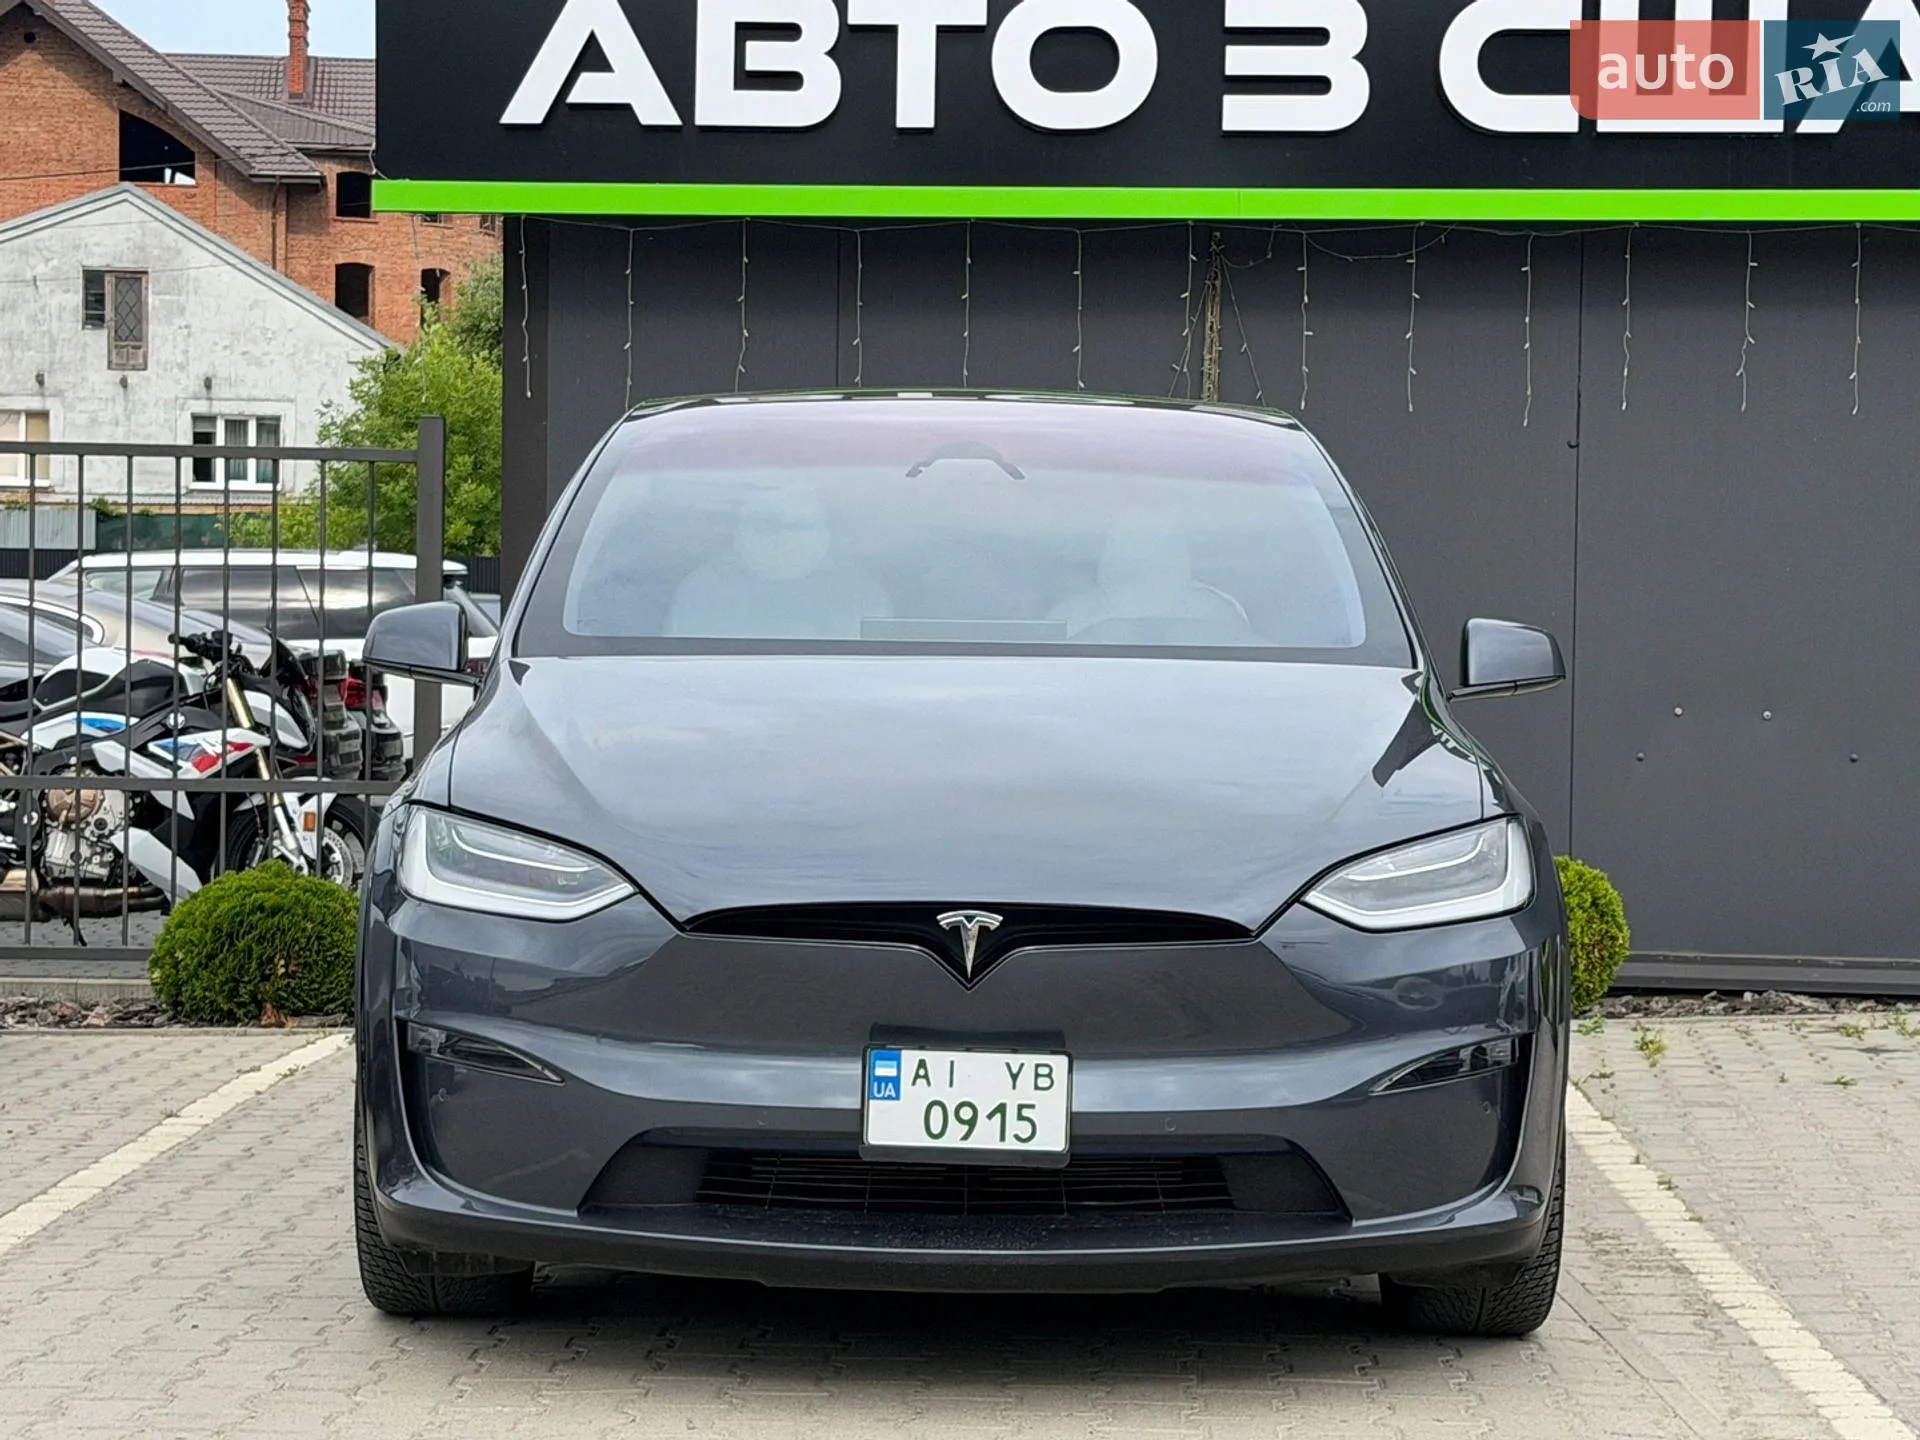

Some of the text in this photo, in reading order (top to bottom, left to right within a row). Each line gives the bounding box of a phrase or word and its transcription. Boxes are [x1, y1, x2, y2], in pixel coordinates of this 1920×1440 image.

[499, 0, 1158, 130] АВТО
[872, 1081, 897, 1099] UA
[923, 1099, 1038, 1144] 0915
